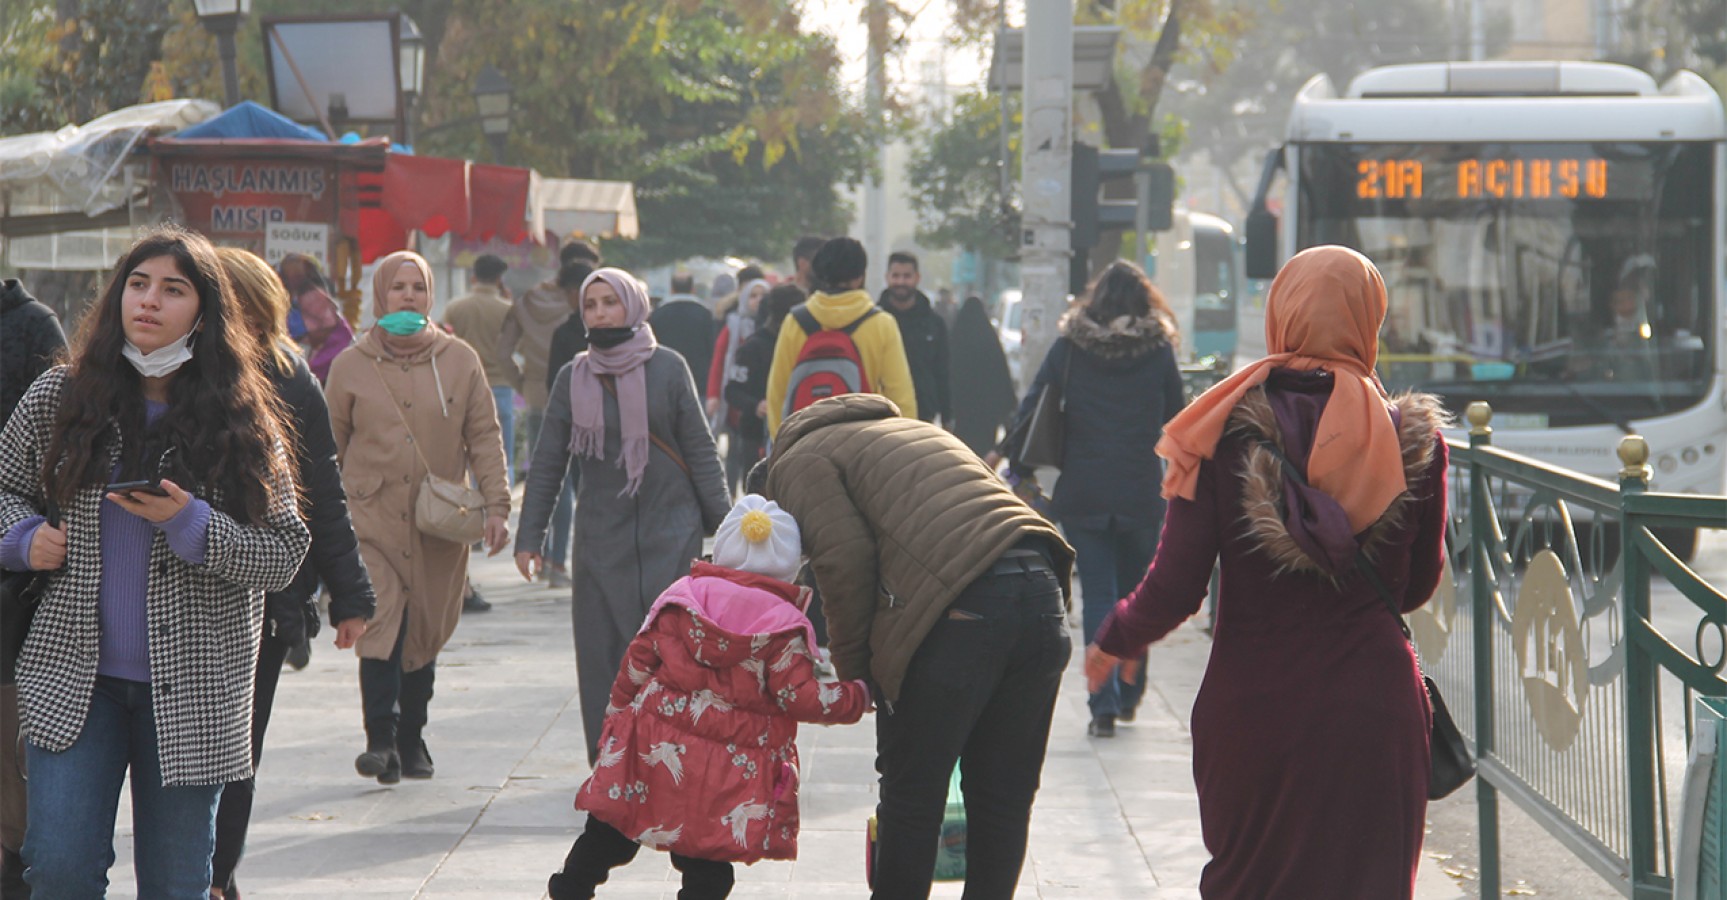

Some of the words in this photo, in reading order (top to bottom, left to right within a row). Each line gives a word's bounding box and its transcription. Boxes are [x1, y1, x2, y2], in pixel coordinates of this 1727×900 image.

[172, 163, 324, 199] HAŞLANMIŞ
[1357, 159, 1422, 199] 21A
[1457, 159, 1607, 199] AÇIKSU
[271, 228, 321, 241] SOĞUK
